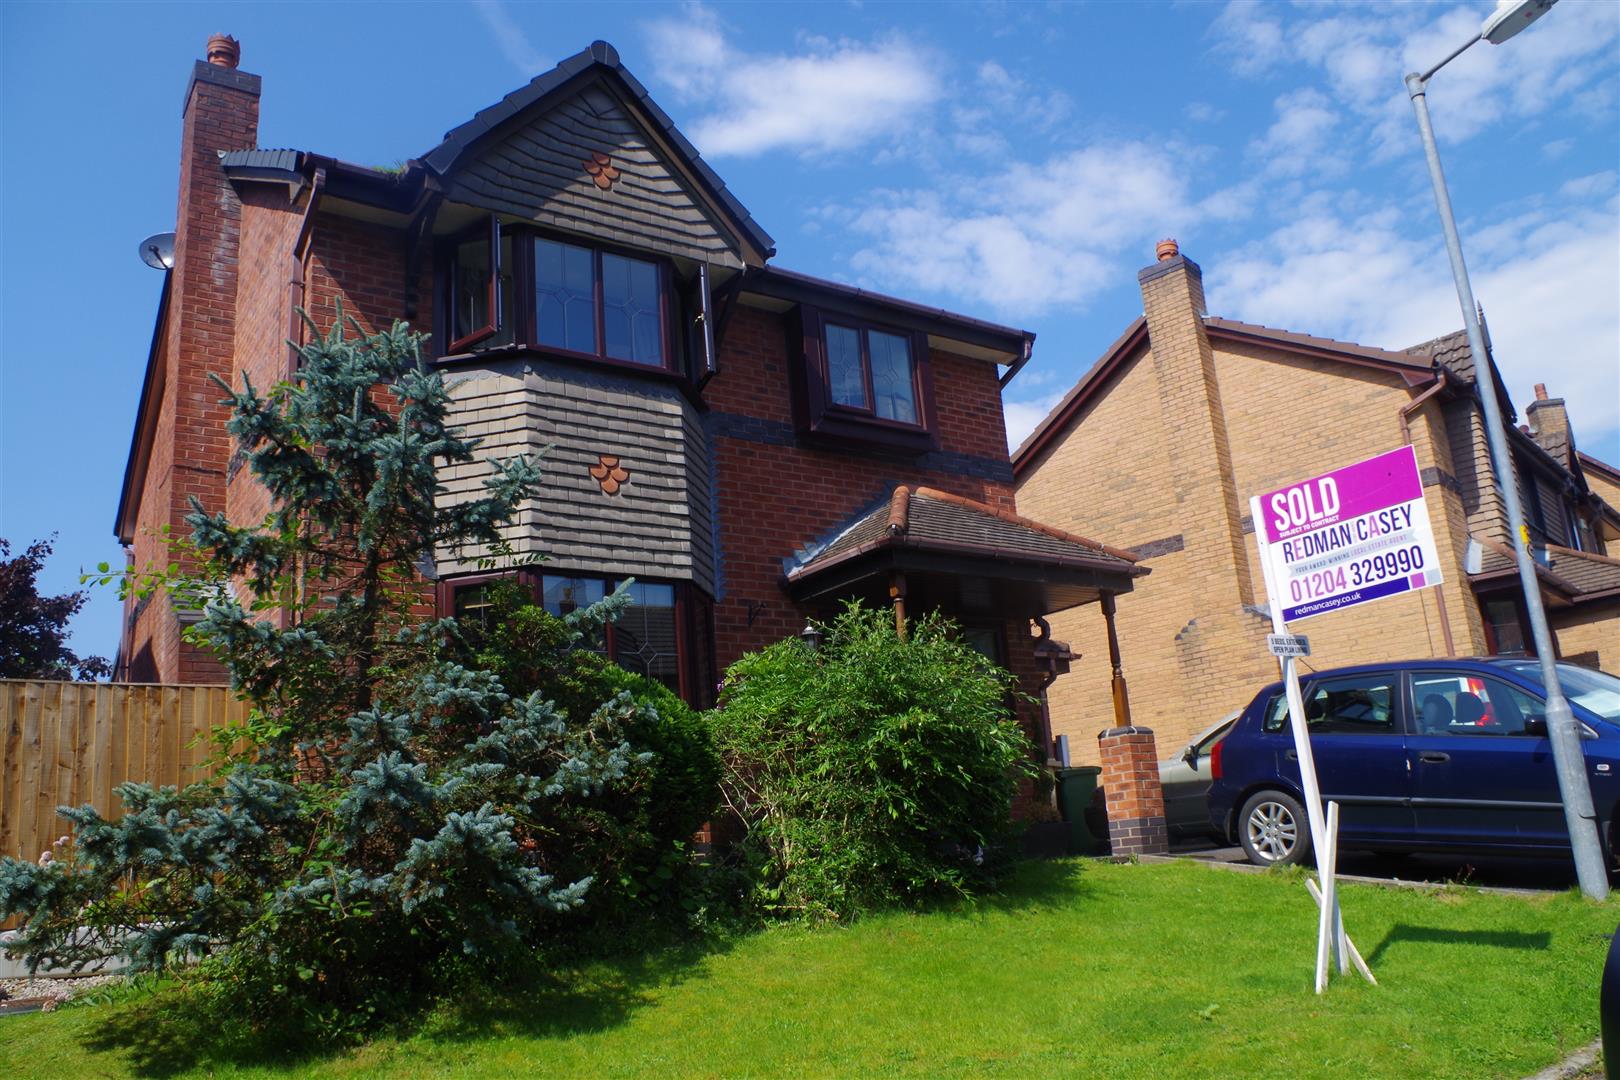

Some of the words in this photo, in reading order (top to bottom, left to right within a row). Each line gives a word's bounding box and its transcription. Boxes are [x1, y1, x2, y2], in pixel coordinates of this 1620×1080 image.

[1271, 476, 1340, 531] SOLD
[1279, 526, 1302, 538] SUBJECT
[1302, 523, 1311, 531] TO
[1311, 515, 1340, 529] CONTRACT
[1282, 523, 1352, 563] REDMAN
[1356, 504, 1411, 541] CASEY
[1290, 566, 1347, 602] 01204
[1350, 545, 1424, 586] 329990
[1295, 592, 1361, 615] redmancasey.co.uk
